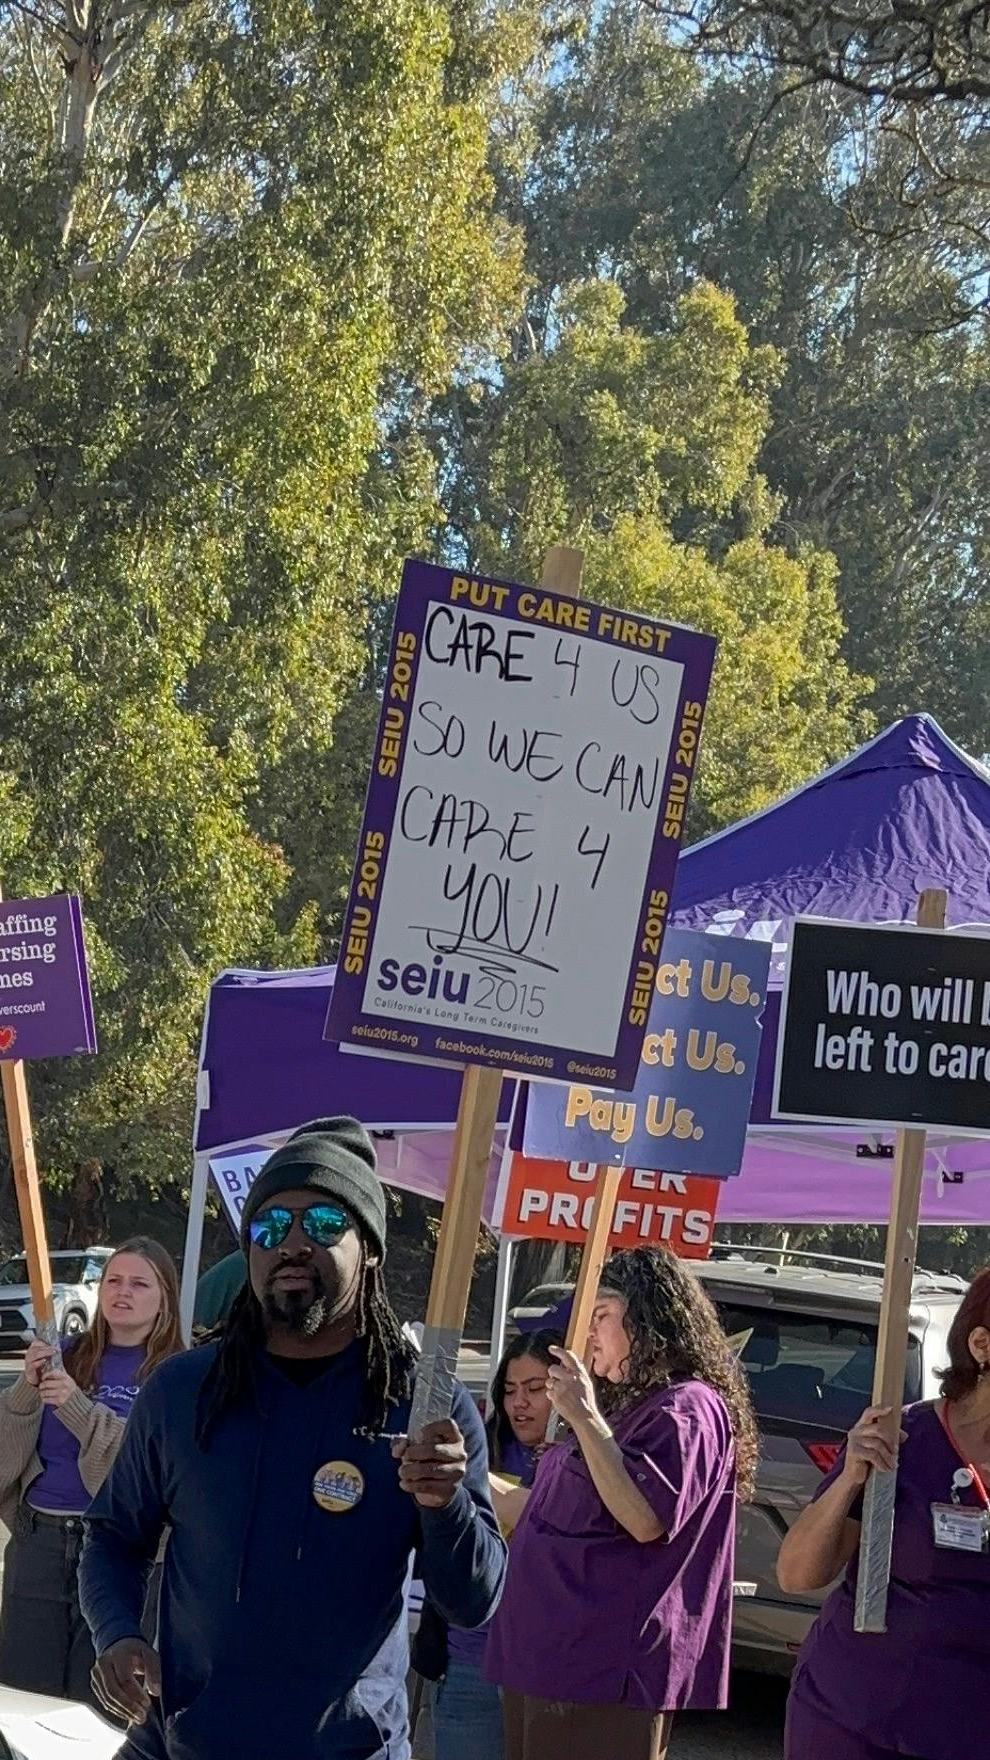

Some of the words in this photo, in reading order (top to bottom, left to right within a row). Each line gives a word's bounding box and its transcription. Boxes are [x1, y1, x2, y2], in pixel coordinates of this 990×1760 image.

[449, 576, 510, 611] PUT
[517, 593, 592, 631] CARE
[597, 612, 672, 652] FIRST
[391, 631, 417, 702] 2015
[424, 606, 536, 682] CARE
[554, 637, 582, 696] 4
[611, 659, 660, 724] US
[378, 707, 406, 778] SEIU
[413, 700, 465, 758] SO
[488, 720, 564, 782] WE
[576, 741, 660, 812] CAN
[662, 773, 690, 839] SEIU
[676, 700, 703, 768] 2015
[357, 830, 386, 900] 2015
[400, 785, 536, 862] CARE
[578, 825, 611, 889] 4
[343, 906, 372, 976] SEIU
[627, 960, 655, 1027] SEIU
[641, 889, 669, 957] 2015
[373, 996, 431, 1016] California's
[434, 1007, 459, 1022] Long
[463, 1012, 488, 1026] Term
[490, 1016, 539, 1035] Caregivers
[376, 954, 472, 1005] seiu
[473, 976, 547, 1019] 2015
[701, 959, 760, 1007] Us.
[826, 969, 902, 1019] Who
[909, 977, 974, 1024] will
[351, 1024, 419, 1047] seiu2015.org
[435, 1036, 555, 1069] facebook.com/seiu2015
[566, 1062, 617, 1080] @seiu2015
[686, 1028, 746, 1076] Us.
[814, 1023, 874, 1072] left
[884, 1031, 920, 1075] to
[565, 1085, 637, 1144] Pay
[645, 1095, 705, 1141] Us.
[569, 1161, 688, 1195] OER
